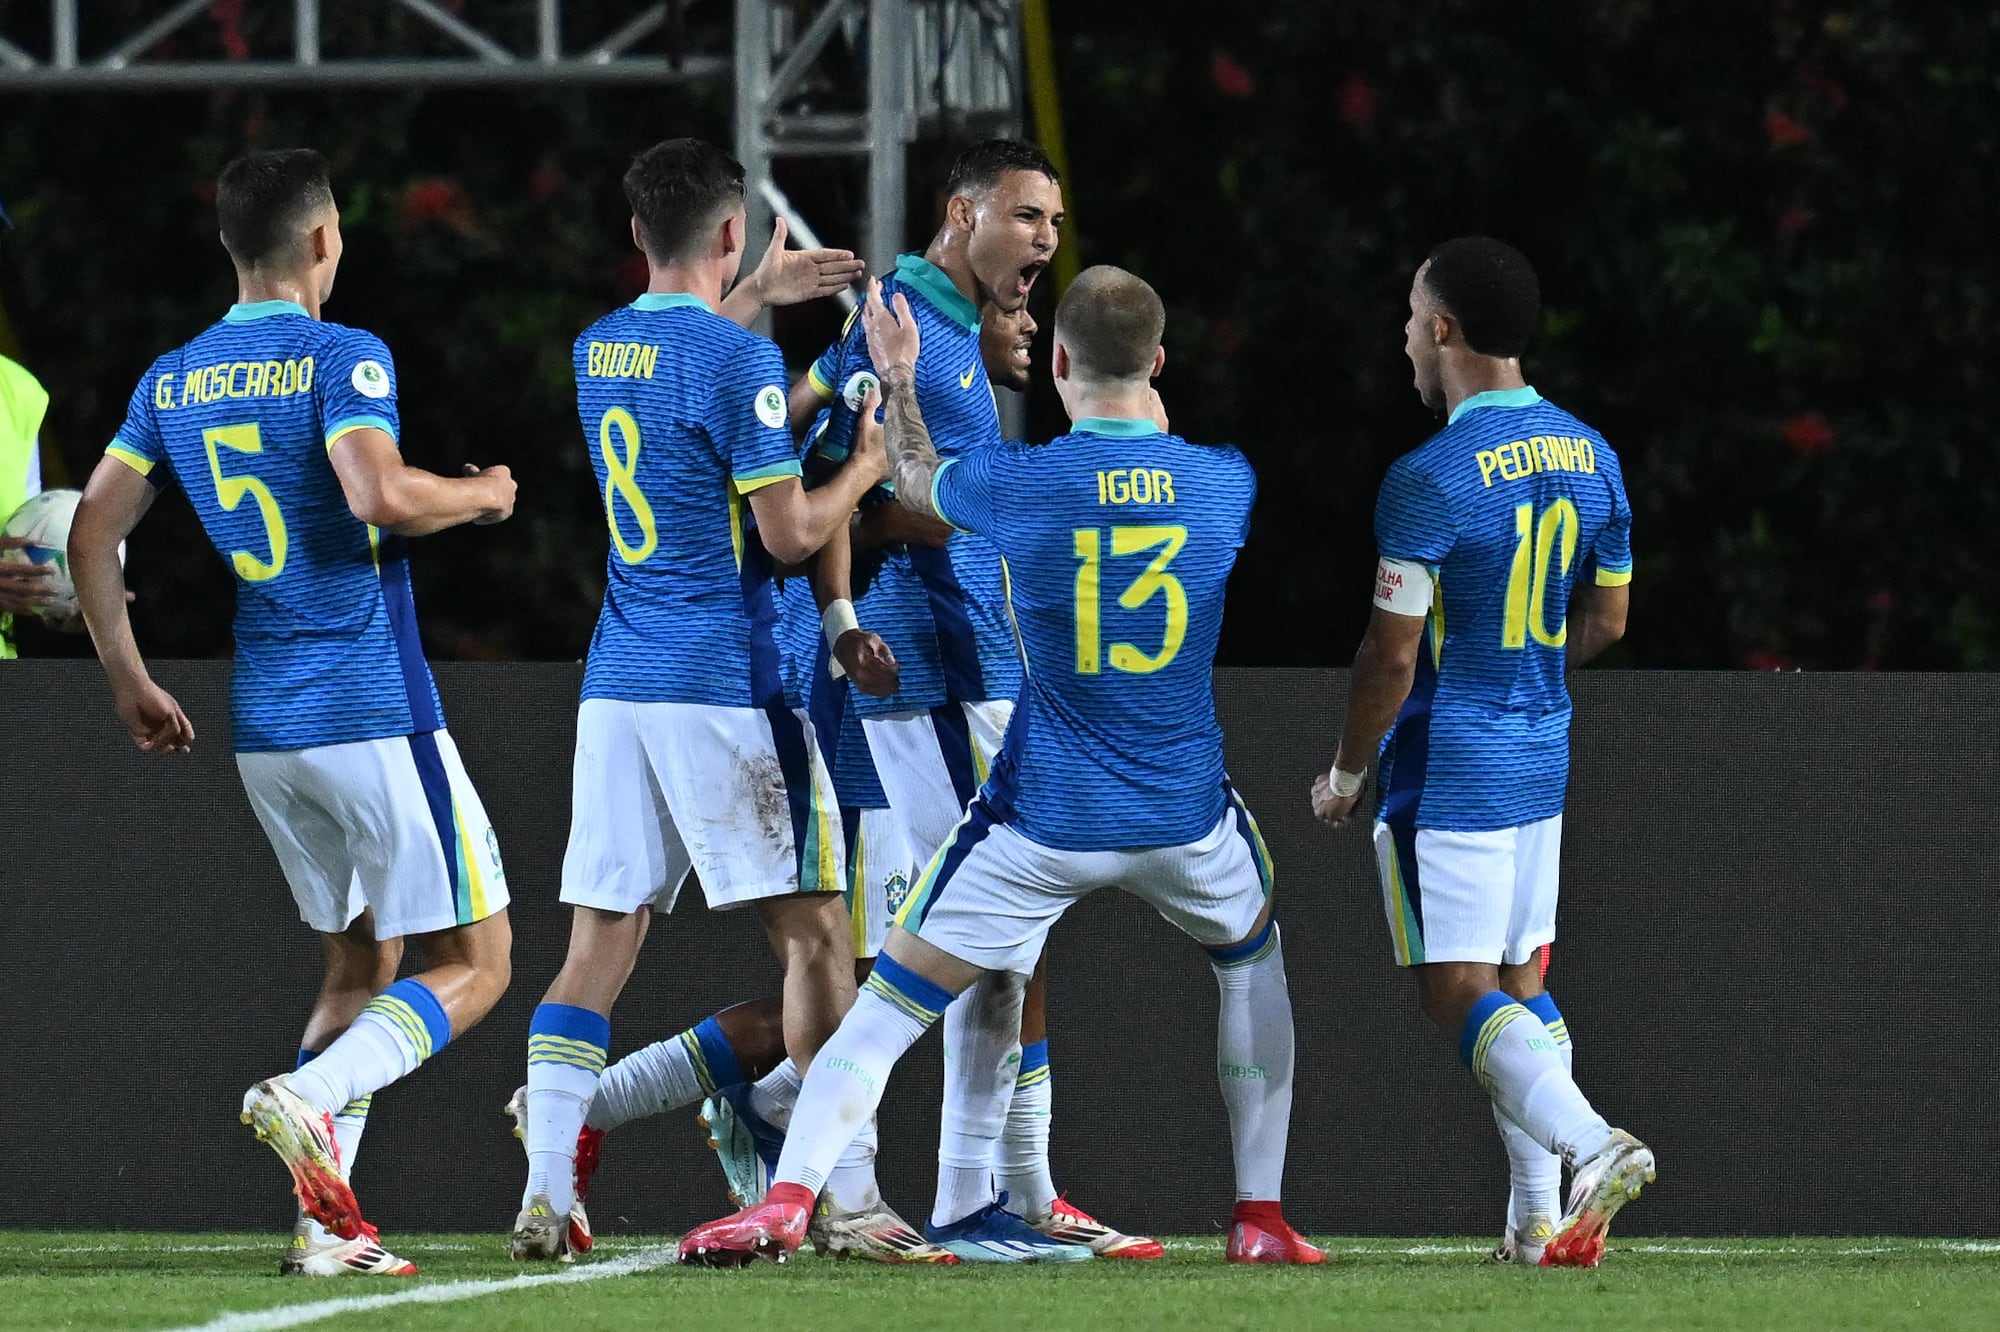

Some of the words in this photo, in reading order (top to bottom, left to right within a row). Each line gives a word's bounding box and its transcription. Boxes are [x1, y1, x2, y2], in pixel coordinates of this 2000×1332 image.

[155, 373, 176, 409] G.
[182, 356, 314, 406] MOSCARDO
[588, 341, 659, 379] BIDON
[202, 422, 288, 582] 5
[600, 406, 658, 565] 8
[1097, 468, 1175, 505] IGOR
[1475, 434, 1595, 488] PEDRINHO
[1073, 524, 1188, 675] 13
[1502, 497, 1580, 649] 10
